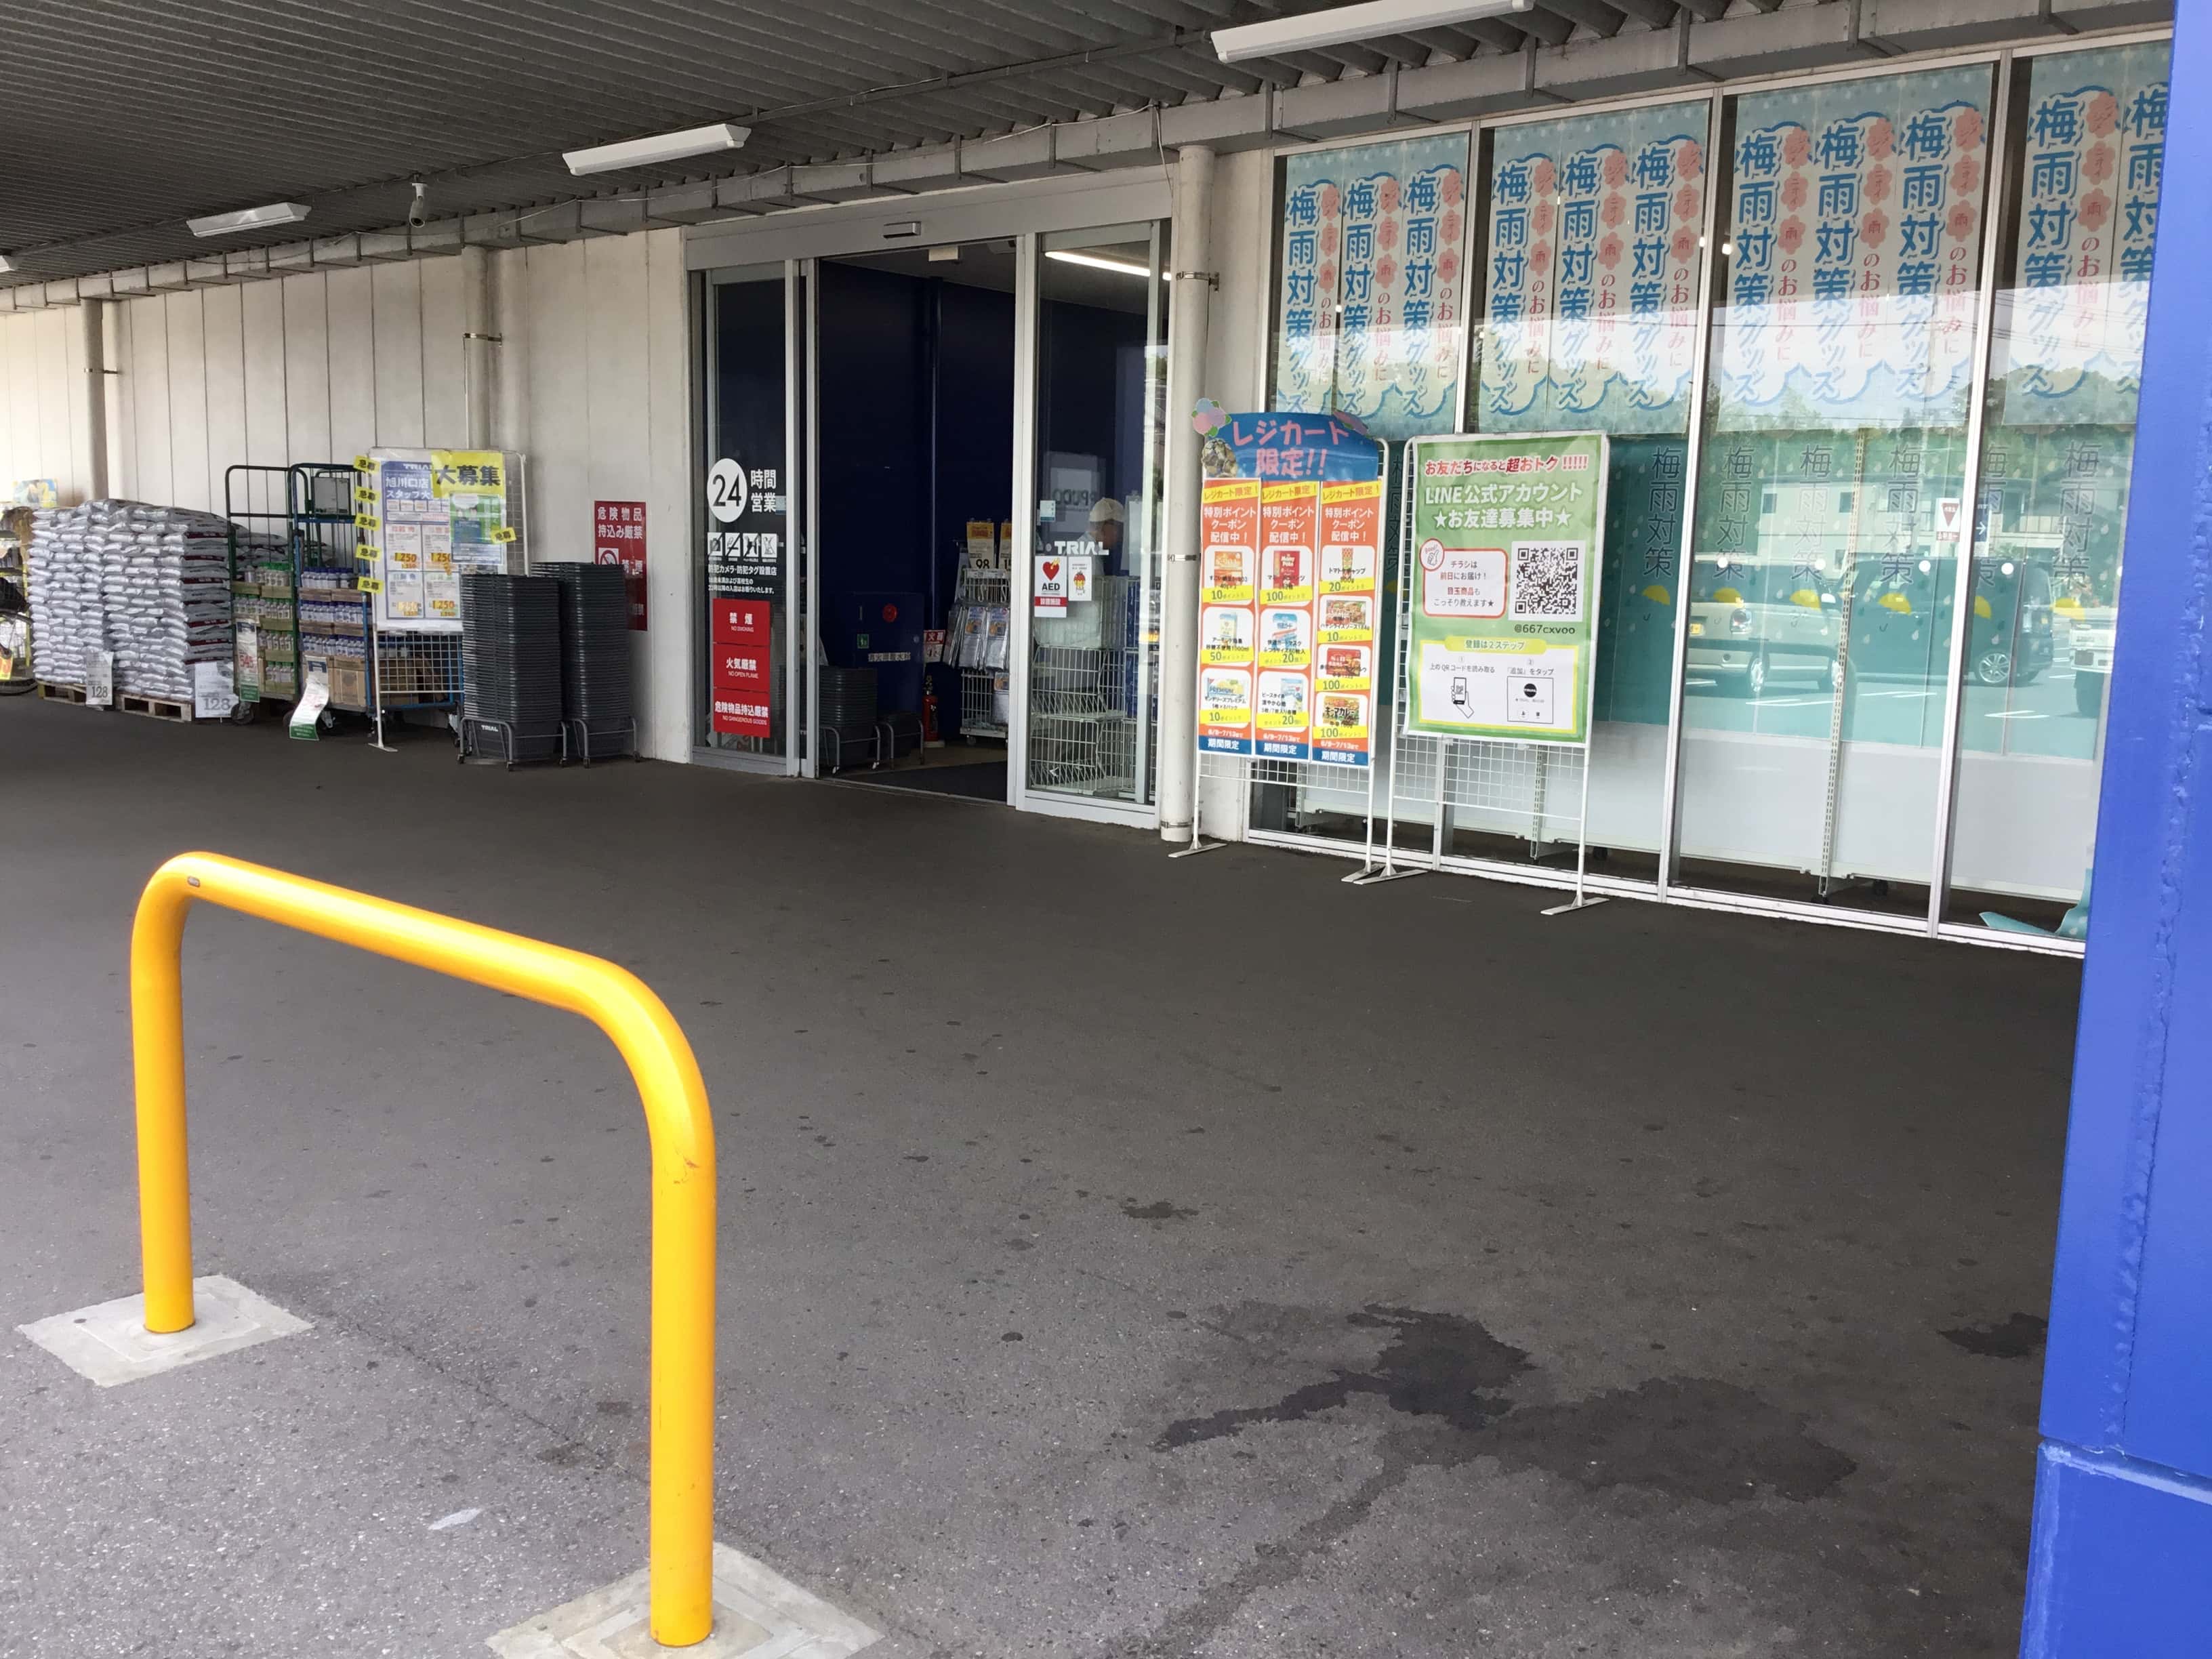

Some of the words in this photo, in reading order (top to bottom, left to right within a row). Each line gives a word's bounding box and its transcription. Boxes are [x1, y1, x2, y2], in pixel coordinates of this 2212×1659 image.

[2022, 98, 2079, 394] 梅雨対策グッズ
[1811, 125, 1859, 402] 梅雨対策グッズ
[1894, 115, 1945, 398] 梅雨対策グッズ
[1629, 147, 1670, 405] 梅雨対策グッズ
[1734, 135, 1776, 405] 梅雨対策グッズ
[1490, 164, 1529, 409] 梅雨対策グッズ
[1559, 156, 1597, 406] 梅雨対策グッズ
[1286, 188, 1316, 412] 梅雨対策グッズ
[1343, 183, 1374, 414] 梅雨対策グッズ
[1403, 176, 1436, 414] 梅雨対策グッズ
[1233, 420, 1349, 446] レジカート
[434, 465, 500, 486] 大募集
[750, 469, 777, 489] 時間
[712, 474, 741, 507] 24
[1425, 483, 1582, 504] LINE公式アカウント
[750, 493, 777, 513] 営業
[597, 507, 642, 521] 危険物品
[1204, 507, 1256, 518] 特別ポイント
[1263, 506, 1314, 518] 特別ポイント
[1326, 508, 1373, 518] 特別ポイント
[1643, 445, 1682, 579] 梅雨対策
[598, 524, 643, 539] 持込み厳禁
[1212, 520, 1246, 529] クーポン
[1271, 520, 1305, 529] クーポン
[1333, 520, 1365, 529] クーポン
[1054, 541, 1109, 556] TRIAL
[1450, 560, 1477, 569] チラシは
[1448, 587, 1480, 596] 目玉商品も
[726, 657, 756, 671] 火気厳禁
[92, 687, 108, 698] 128
[203, 698, 230, 710] 128
[1208, 738, 1239, 750] 期間限定
[1264, 743, 1296, 754] 期間限定
[1322, 750, 1355, 763] 期間限定
